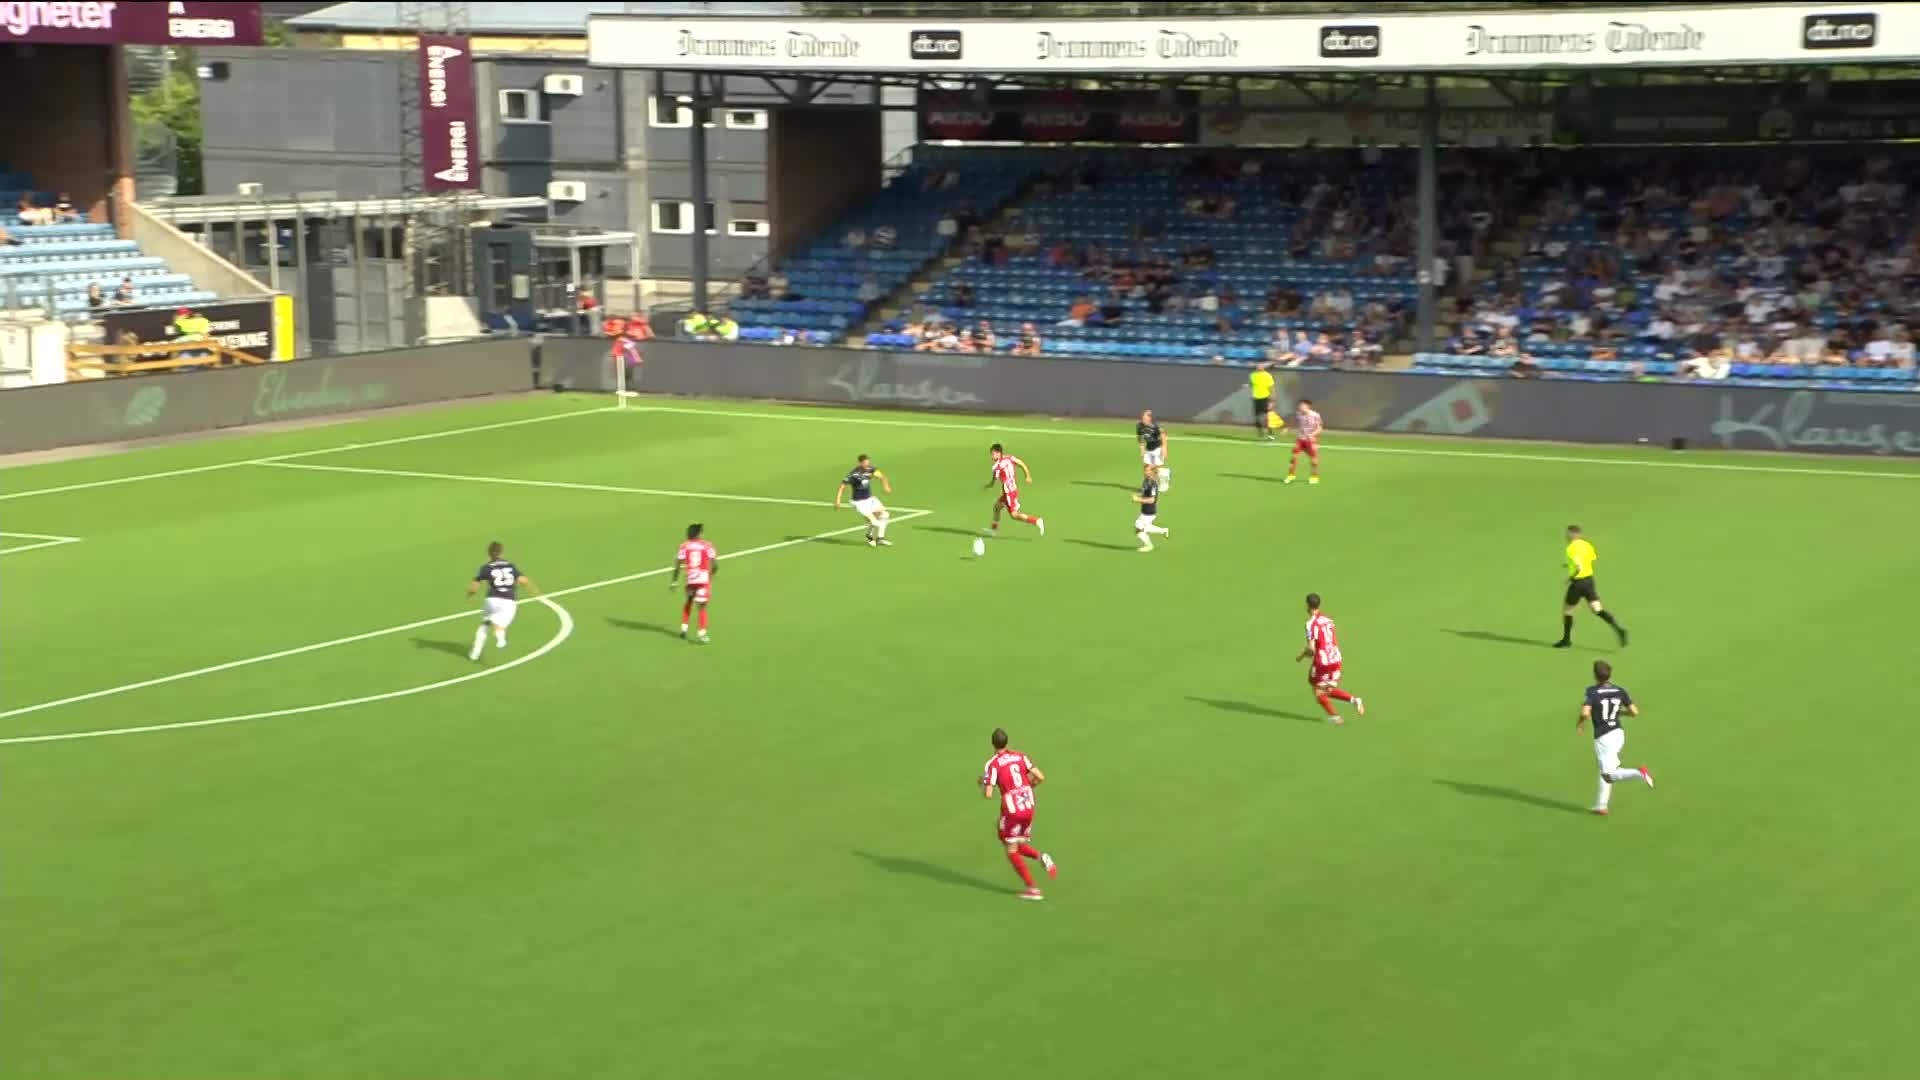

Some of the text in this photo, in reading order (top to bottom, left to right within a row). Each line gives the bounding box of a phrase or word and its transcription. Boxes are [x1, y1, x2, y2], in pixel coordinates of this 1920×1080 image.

[490, 566, 515, 587] 25
[1600, 698, 1621, 721] 17
[1009, 763, 1023, 787] 6
